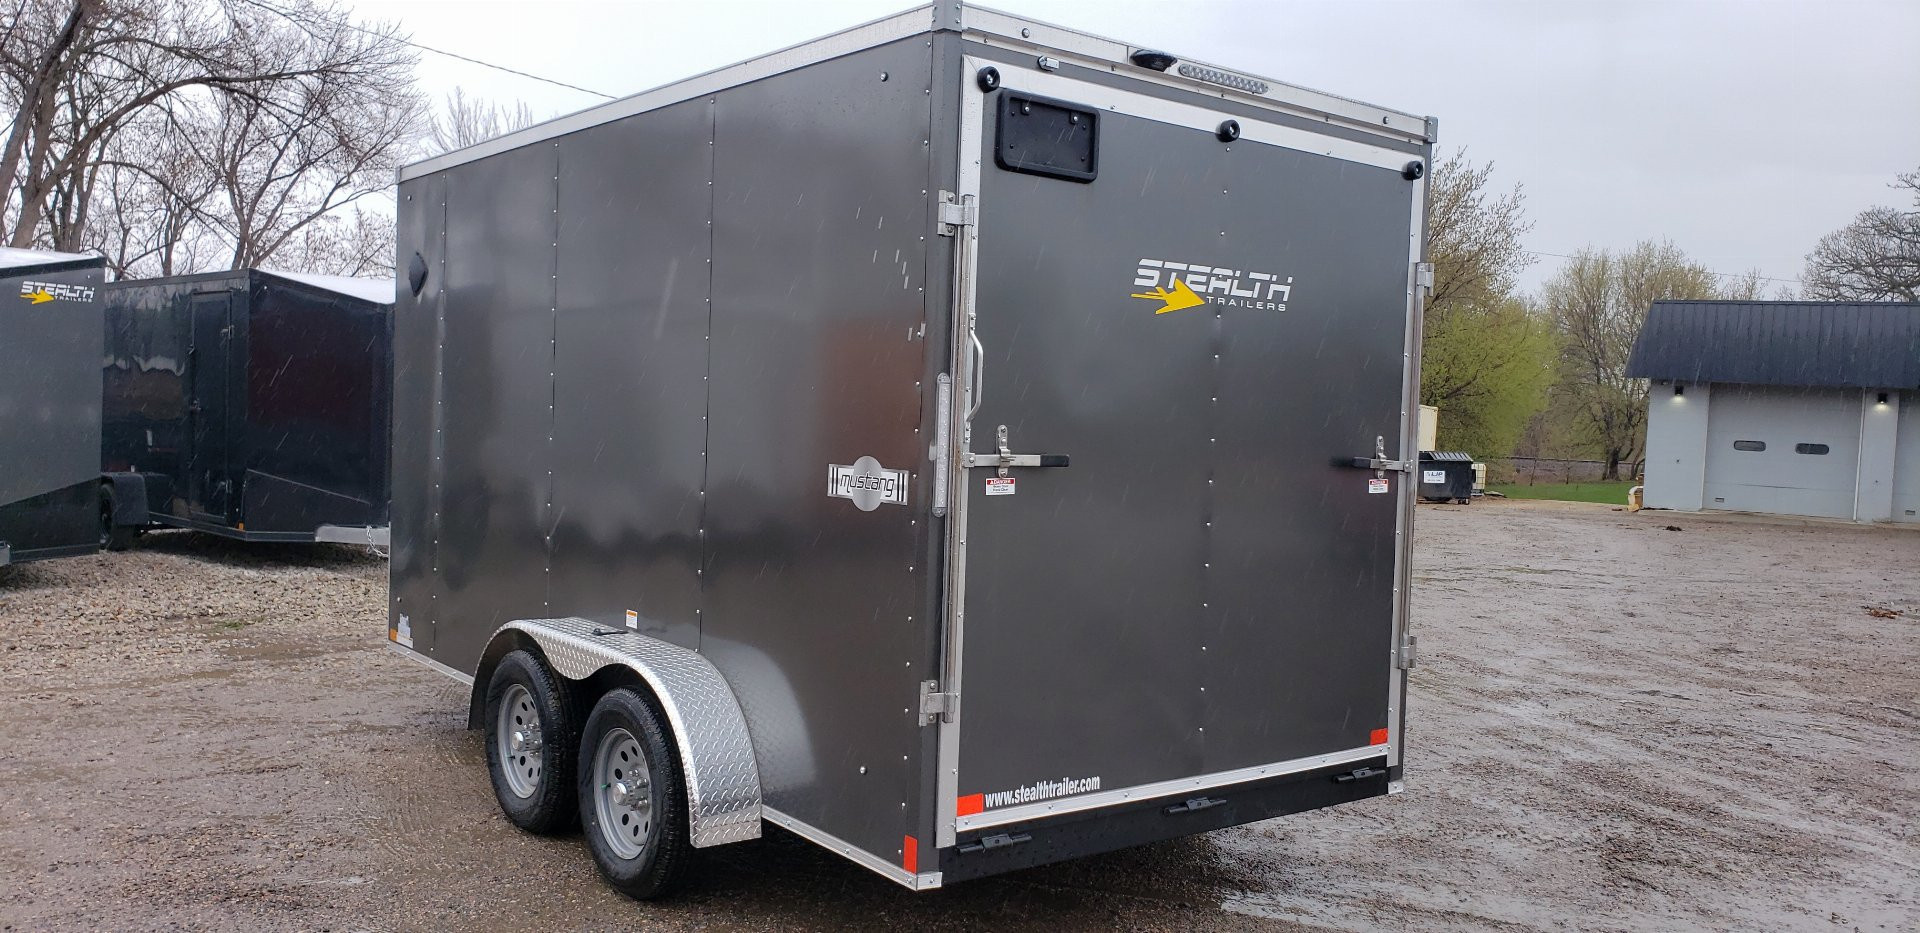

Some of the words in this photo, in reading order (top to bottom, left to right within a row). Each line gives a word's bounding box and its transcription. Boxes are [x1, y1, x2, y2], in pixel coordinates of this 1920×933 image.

[21, 280, 95, 299] STEALTH
[1134, 258, 1293, 302] STEALTH
[55, 295, 93, 303] TRAILERS
[1206, 295, 1287, 312] TRAILERS
[840, 472, 895, 498] mustang
[985, 775, 1100, 808] www.stealthtrailer.com
